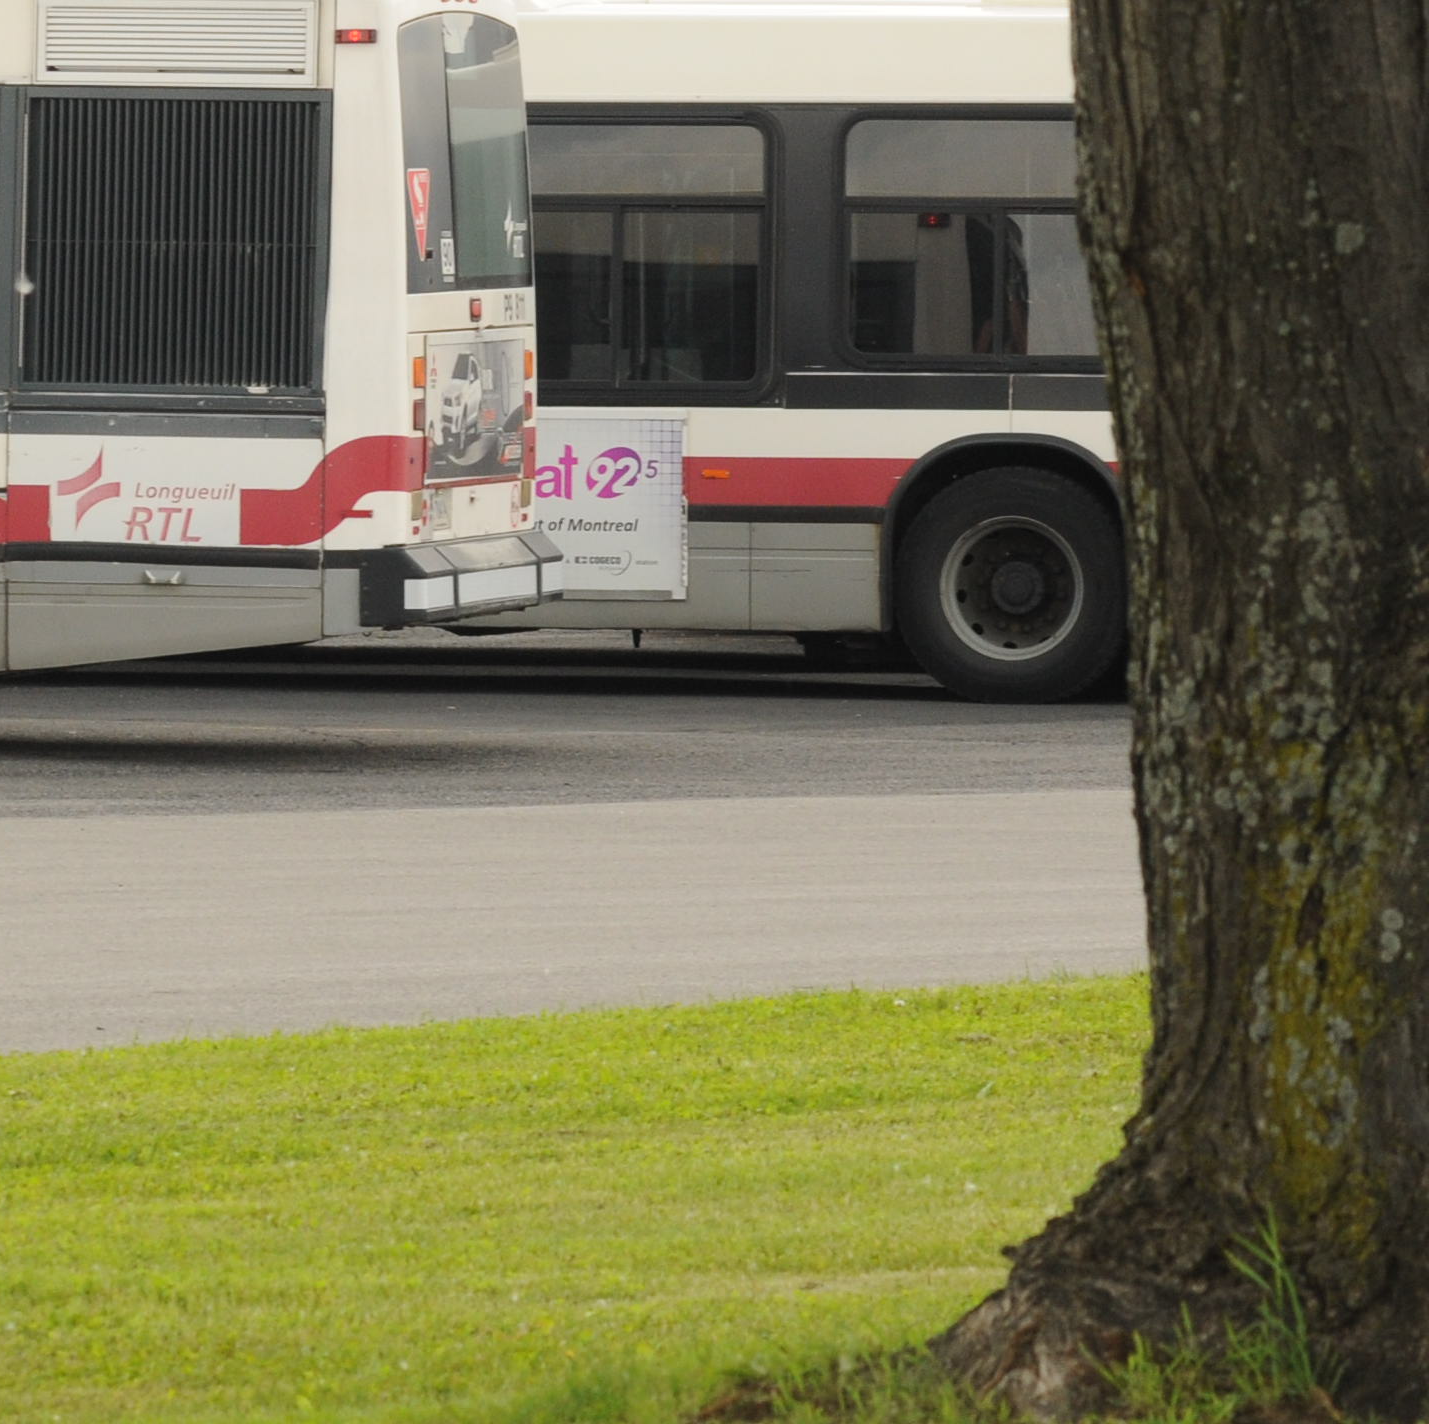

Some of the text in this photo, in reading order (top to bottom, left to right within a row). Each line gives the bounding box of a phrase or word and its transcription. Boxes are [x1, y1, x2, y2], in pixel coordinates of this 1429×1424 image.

[535, 444, 578, 500] at
[645, 460, 659, 479] 5
[135, 482, 236, 503] Longueuil
[123, 506, 202, 542] RTL
[548, 517, 565, 531] of
[567, 518, 639, 532] Montreal
